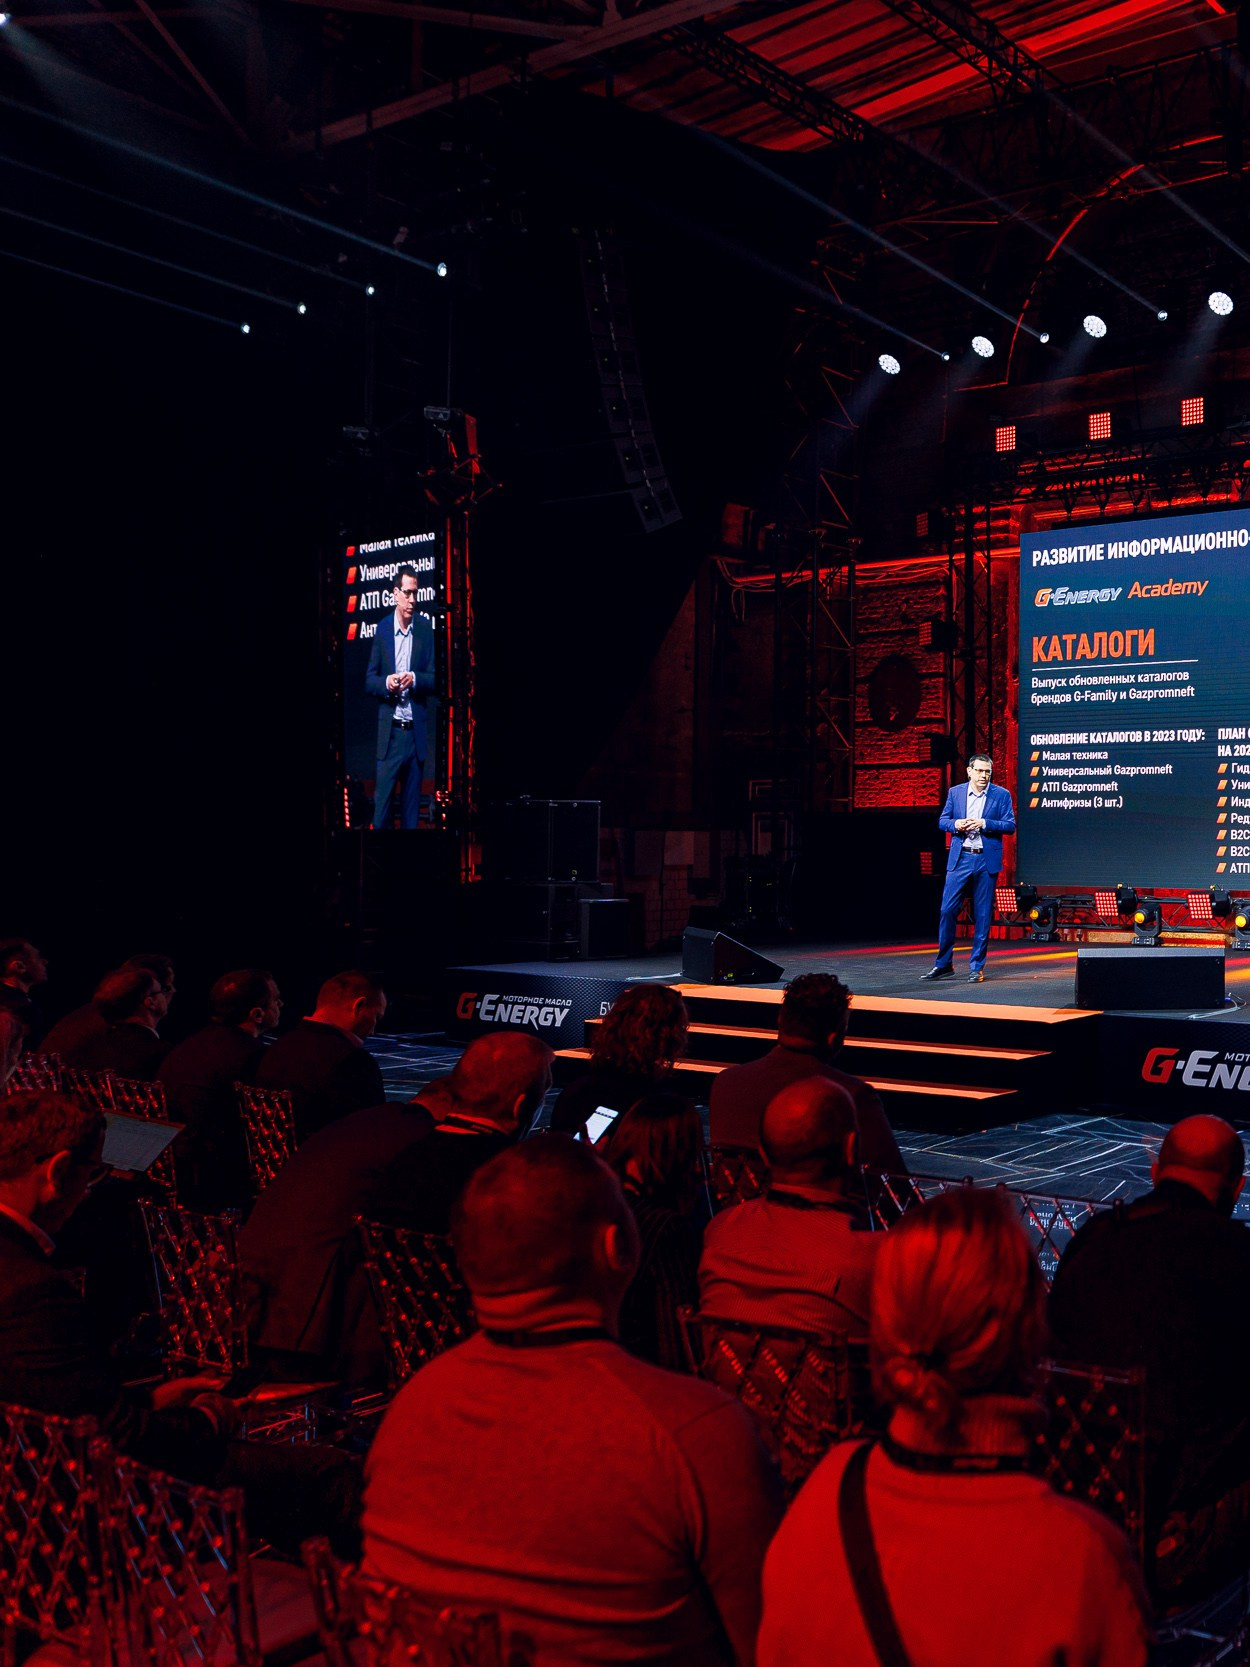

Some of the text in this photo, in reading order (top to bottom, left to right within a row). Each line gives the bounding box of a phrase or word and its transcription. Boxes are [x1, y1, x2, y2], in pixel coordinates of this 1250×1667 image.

[1032, 544, 1104, 567] РАЗВИТИЕ
[1127, 578, 1209, 599] Academy
[360, 591, 380, 611] АТП
[1032, 628, 1155, 662] КАТАЛОГИ
[1032, 671, 1189, 690] Выпуск обновленных каталогов
[1031, 685, 1195, 706] брендов G-Family и Gazpromneft
[1031, 729, 1205, 745] ОБНОВЛЕНИЕ КАТАЛОГОВ В 2023 ГОДУ:
[1218, 728, 1246, 740] ПЛАН
[1042, 751, 1108, 761] Малая техника
[1217, 745, 1232, 757] НА
[1042, 764, 1172, 778] Универсальный Gazpromneft
[1042, 781, 1118, 794] АТП Gazpromneft
[1041, 796, 1123, 810] Антифризы (3 шт.)
[1230, 829, 1250, 840] B2C
[1230, 846, 1250, 857] B2C
[1229, 862, 1250, 874] АТП
[502, 995, 572, 1007] МОТОРНОЕ МАСЛО
